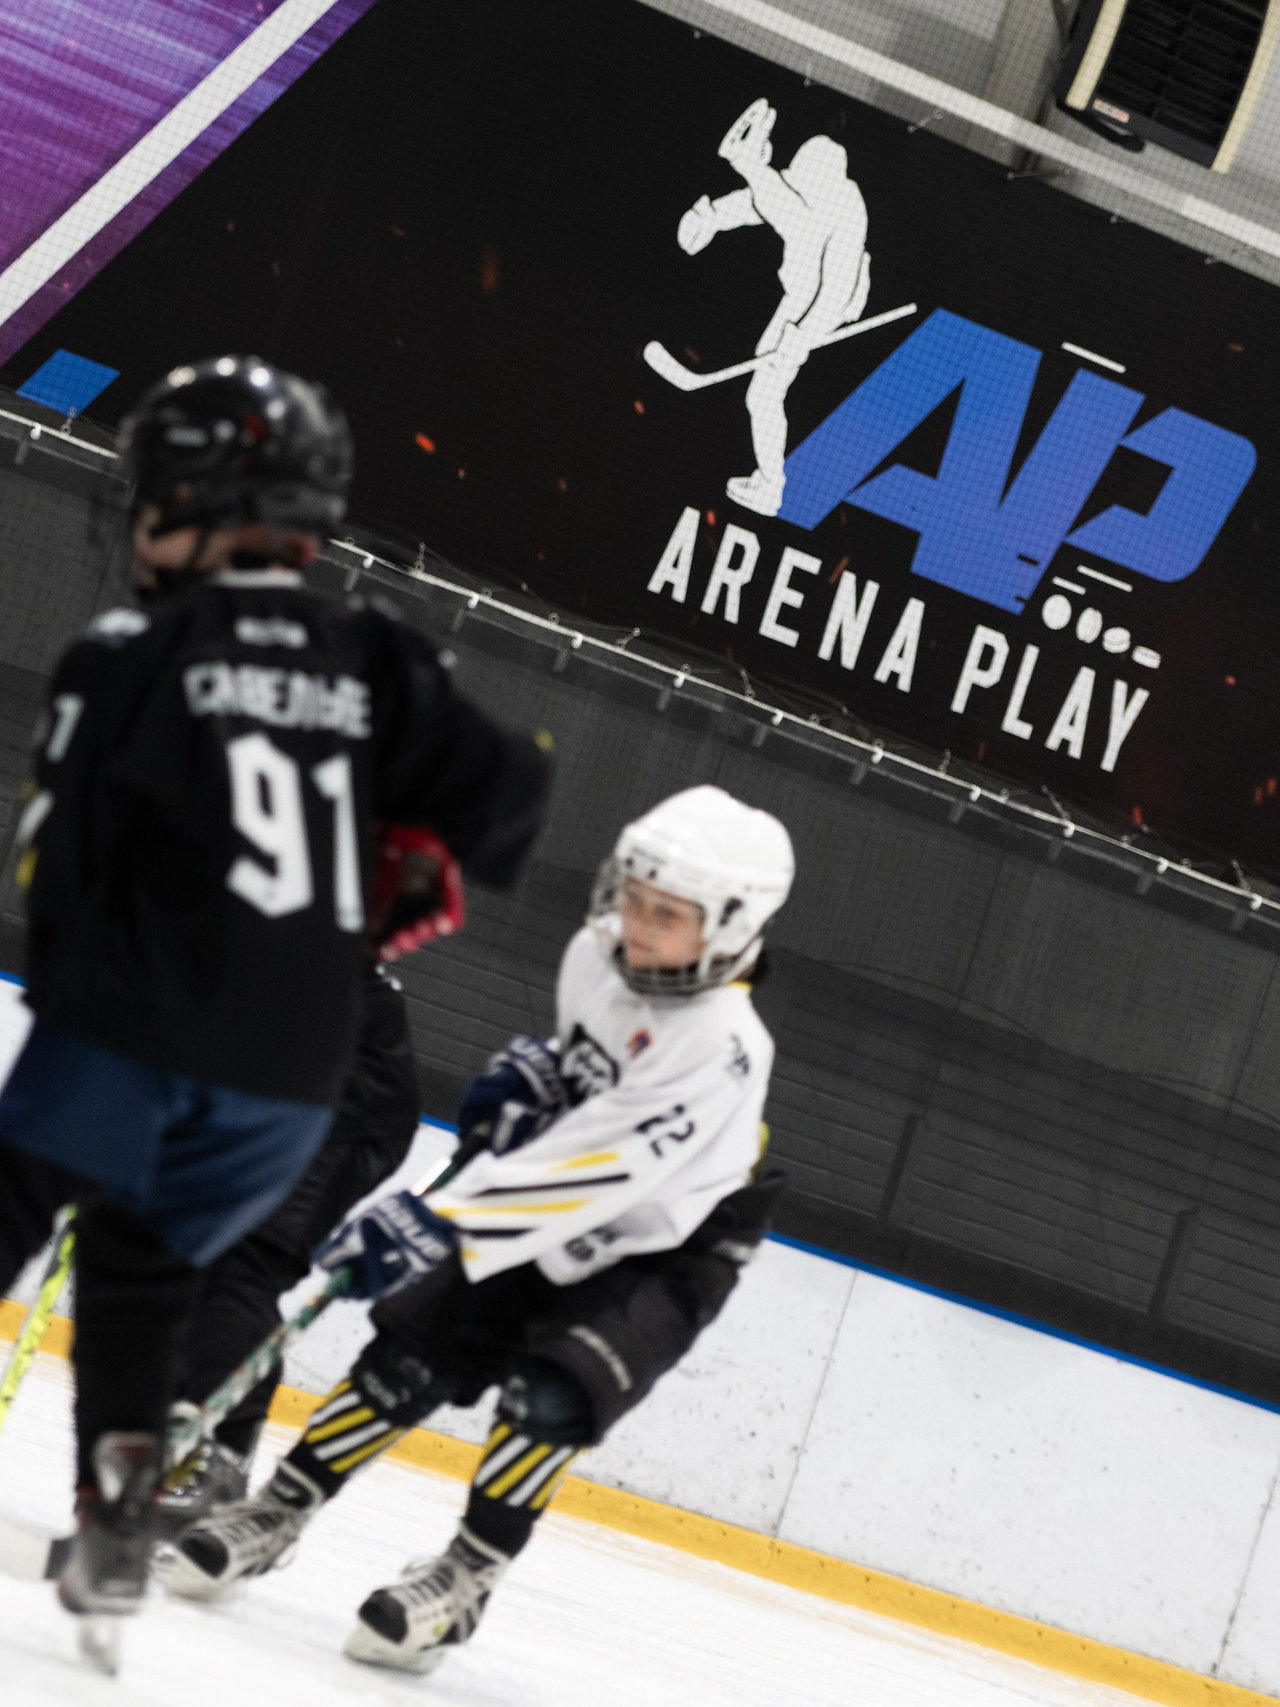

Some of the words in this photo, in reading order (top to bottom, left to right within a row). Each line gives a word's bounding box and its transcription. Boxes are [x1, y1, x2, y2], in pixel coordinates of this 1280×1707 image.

[646, 506, 925, 693] ARENA
[950, 624, 1150, 773] PLAY
[225, 732, 365, 933] 91
